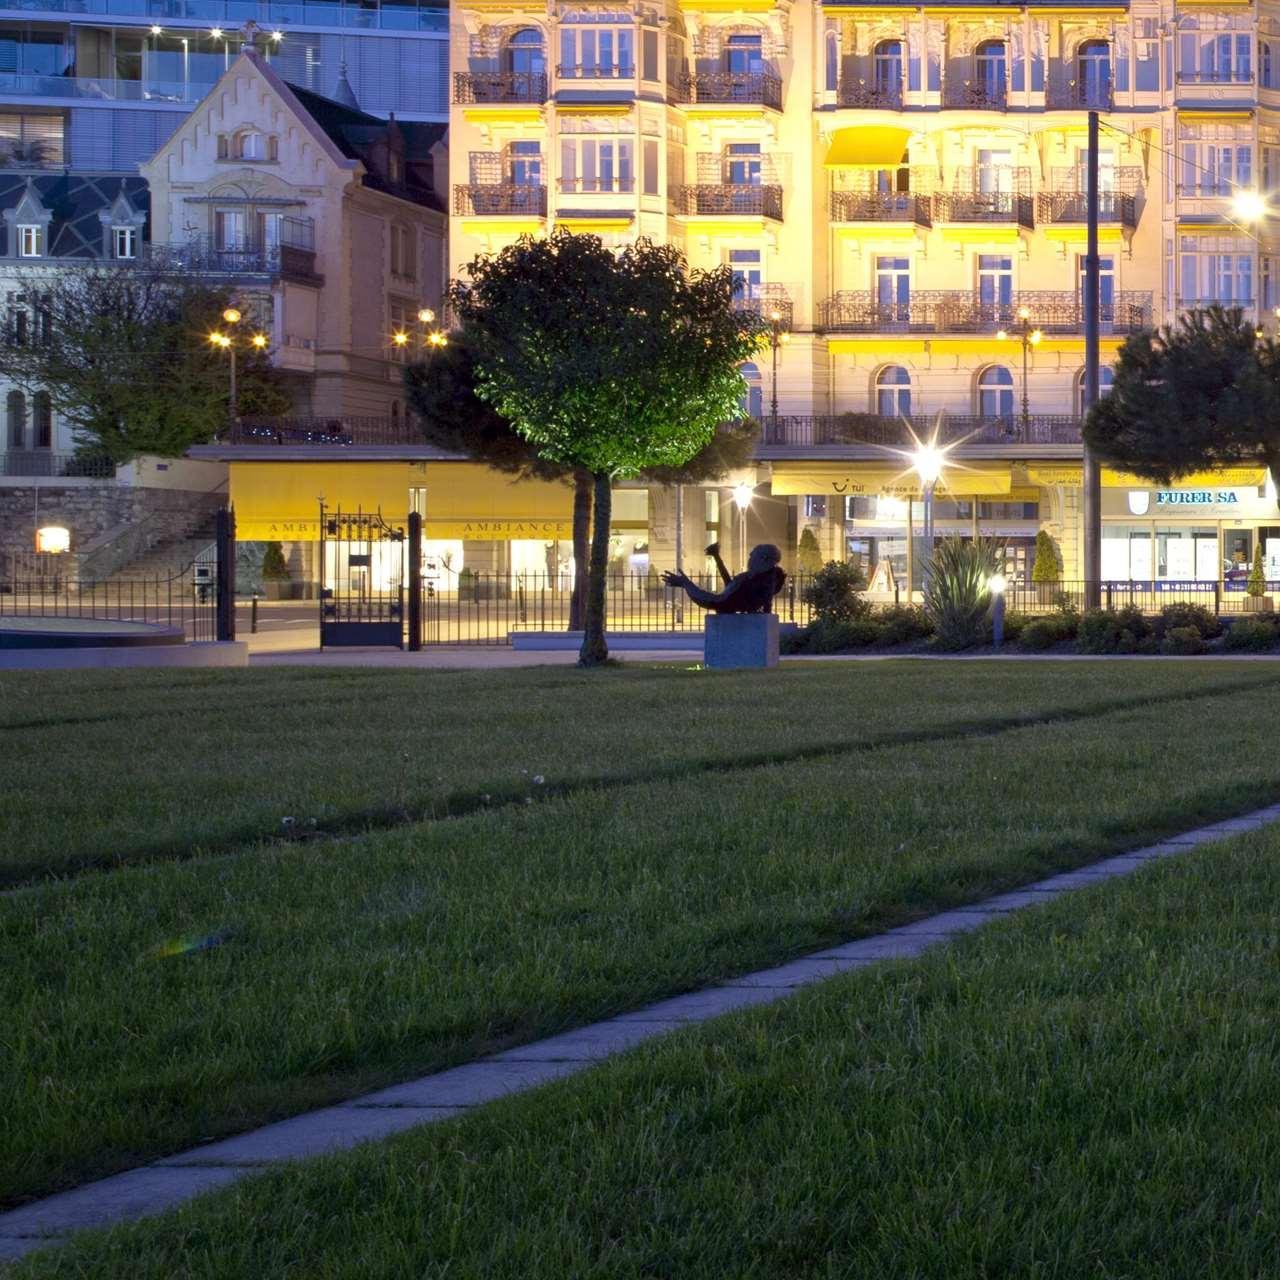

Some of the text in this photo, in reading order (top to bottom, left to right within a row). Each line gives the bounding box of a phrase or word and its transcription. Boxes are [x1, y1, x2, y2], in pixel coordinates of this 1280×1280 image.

[1156, 491, 1238, 504] FURER SA
[463, 522, 566, 532] AMBIANCE
